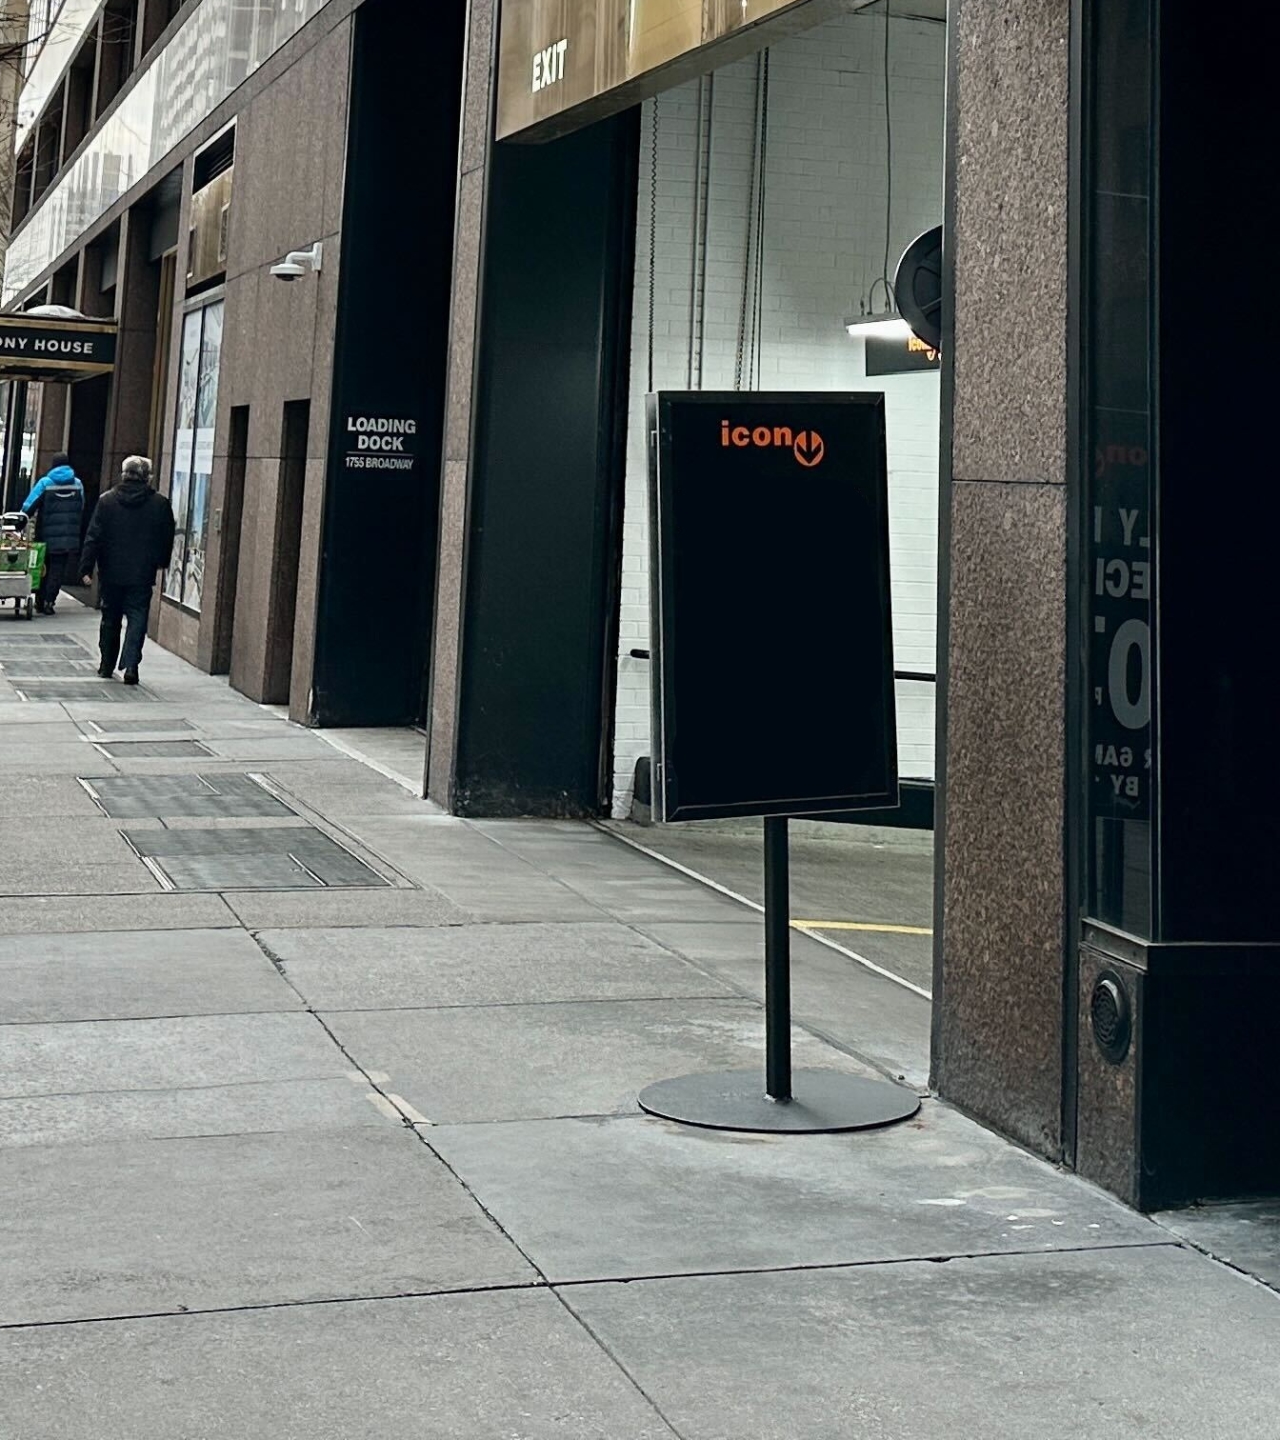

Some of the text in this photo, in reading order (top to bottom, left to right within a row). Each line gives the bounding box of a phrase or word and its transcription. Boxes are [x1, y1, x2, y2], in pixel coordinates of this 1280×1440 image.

[531, 38, 568, 93] EXIT
[34, 339, 94, 355] HOUSE
[346, 416, 417, 434] LOADING
[721, 420, 793, 447] icon
[357, 434, 404, 451] DOCK
[345, 456, 414, 470] 1755 BROADWAY
